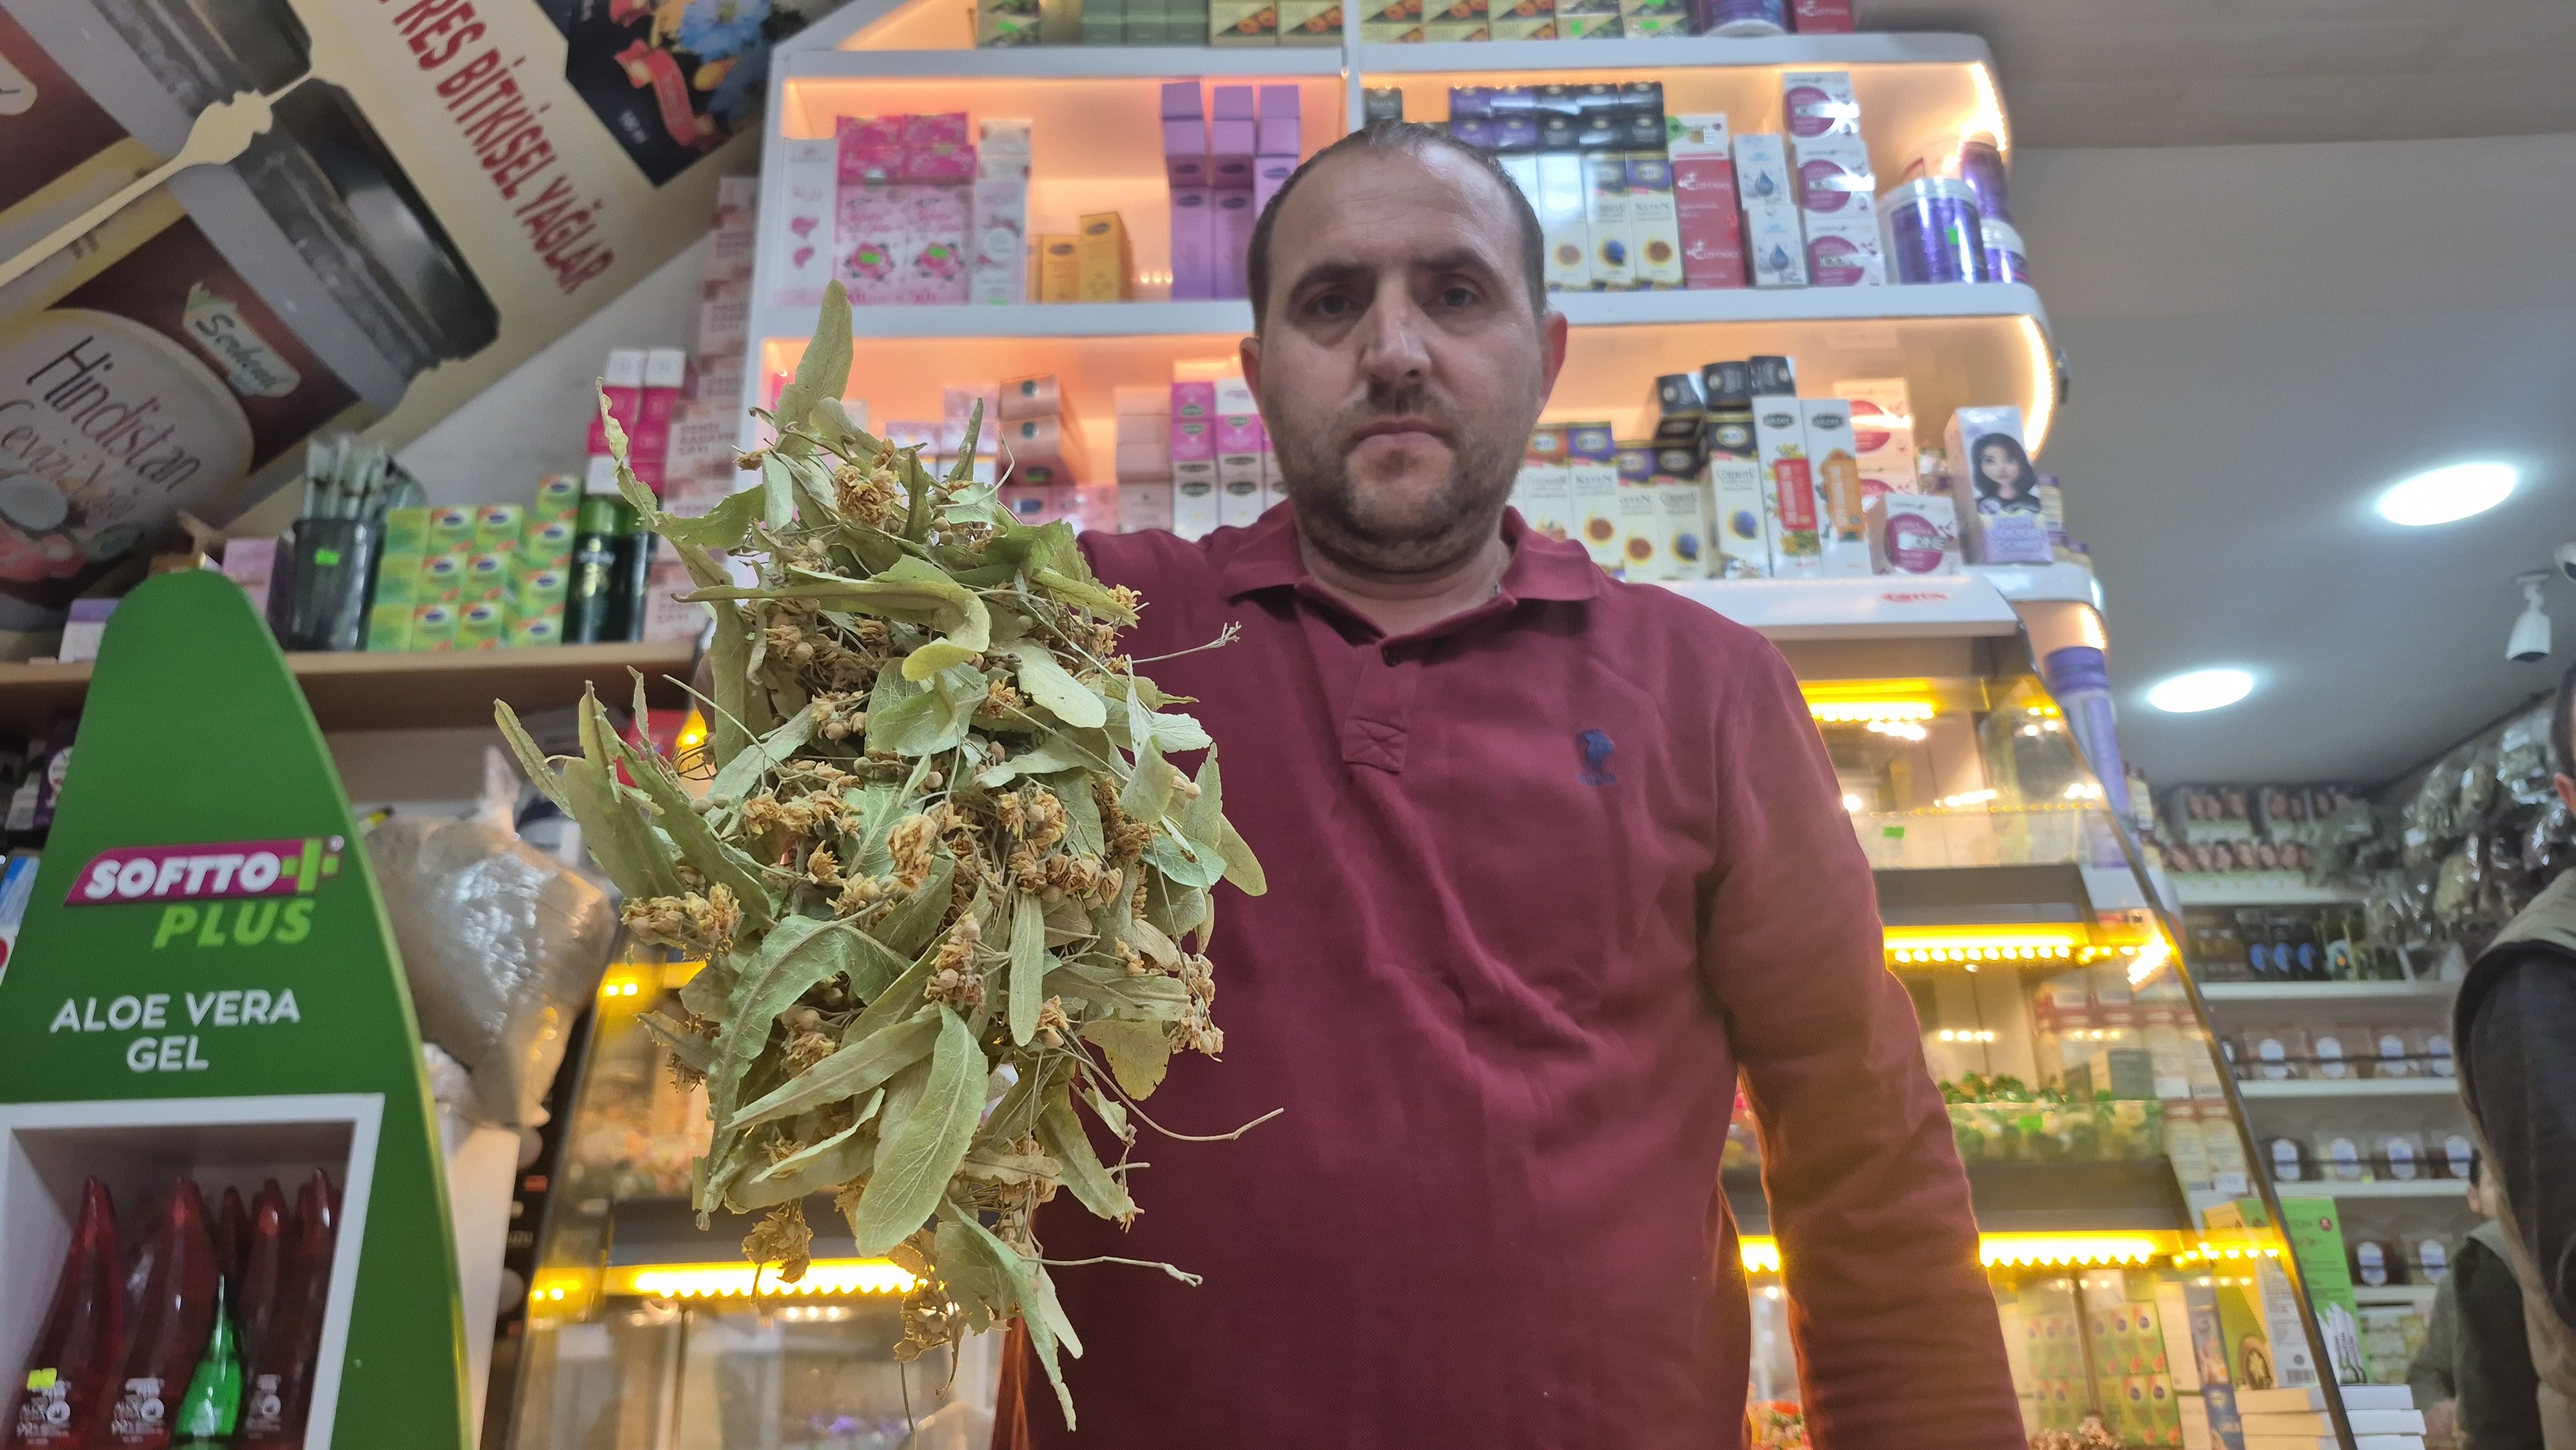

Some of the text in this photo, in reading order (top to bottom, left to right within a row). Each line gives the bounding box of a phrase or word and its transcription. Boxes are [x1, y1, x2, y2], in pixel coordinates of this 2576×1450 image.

[514, 174, 616, 296] YAĞLAR
[26, 335, 201, 493] Hindistan
[152, 899, 316, 949] PLUS
[50, 988, 301, 1033] ALOE VERA
[126, 1035, 209, 1073] GEL
